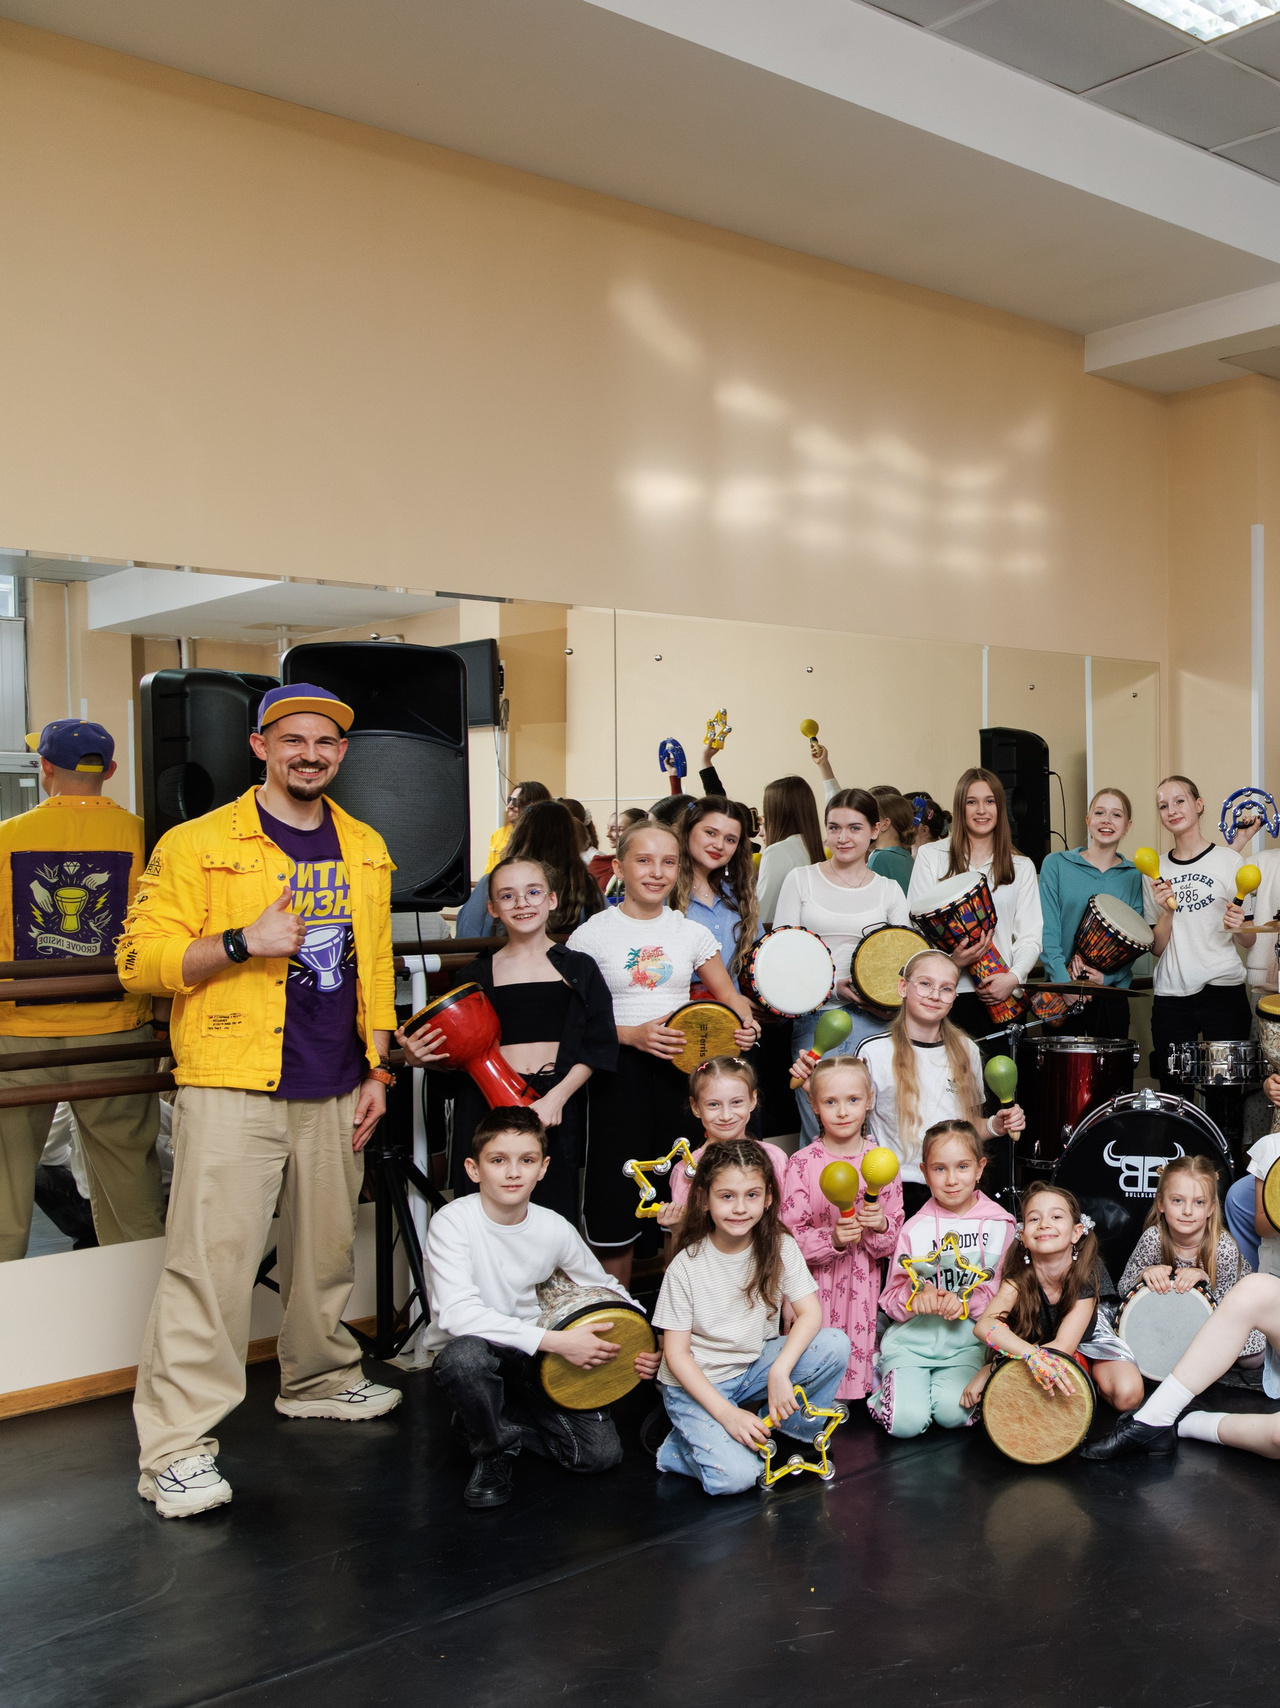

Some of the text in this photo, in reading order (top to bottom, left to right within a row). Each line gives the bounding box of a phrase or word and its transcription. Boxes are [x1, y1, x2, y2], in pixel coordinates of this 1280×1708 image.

[1169, 873, 1215, 888] ILFIGER
[290, 889, 352, 917] ИЗН
[1174, 889, 1199, 904] 1985
[1187, 893, 1216, 913] YORK
[699, 1033, 708, 1057] Terris
[931, 1233, 989, 1252] NOODYS
